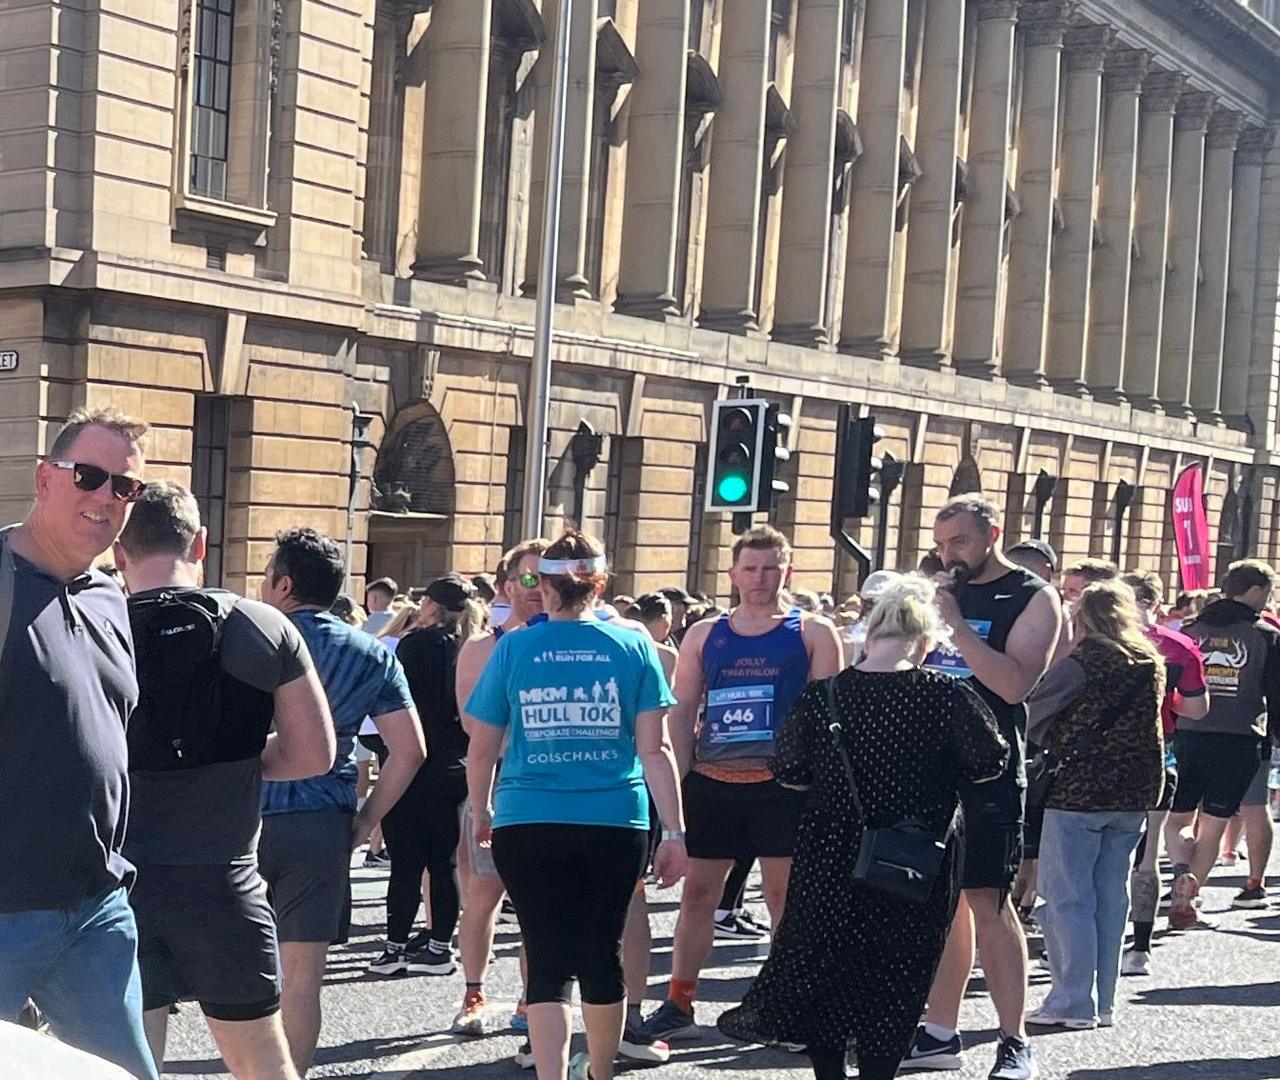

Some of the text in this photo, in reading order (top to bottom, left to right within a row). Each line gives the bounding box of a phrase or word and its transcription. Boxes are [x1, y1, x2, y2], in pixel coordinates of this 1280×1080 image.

[595, 654, 611, 662] ALL
[519, 686, 568, 704] MKM
[524, 706, 616, 724] HULL 10K
[722, 707, 754, 724] 646
